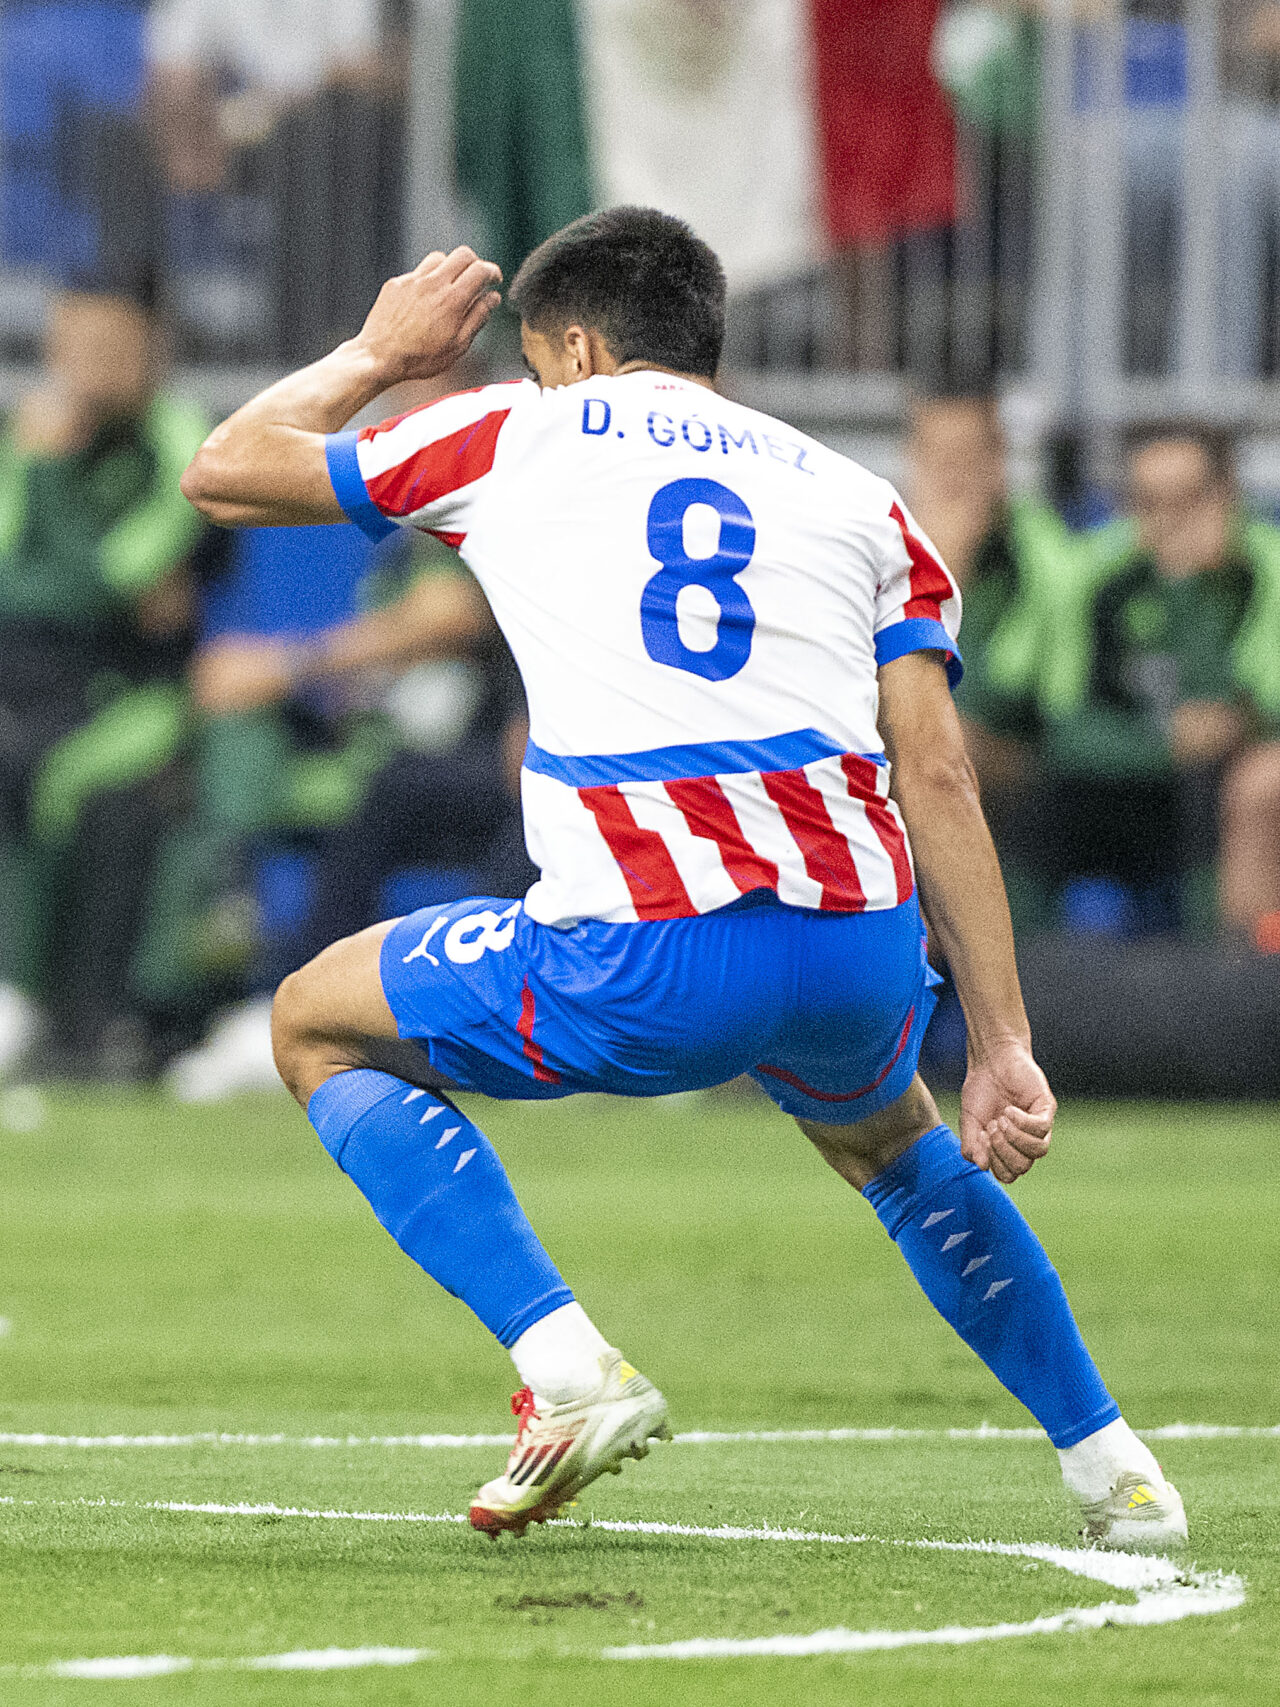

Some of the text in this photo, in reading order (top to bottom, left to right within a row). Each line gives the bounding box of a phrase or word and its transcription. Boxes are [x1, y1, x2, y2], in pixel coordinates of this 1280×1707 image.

[582, 398, 815, 475] D. GÓMEZ
[640, 477, 756, 682] 8
[445, 900, 521, 964] 8
